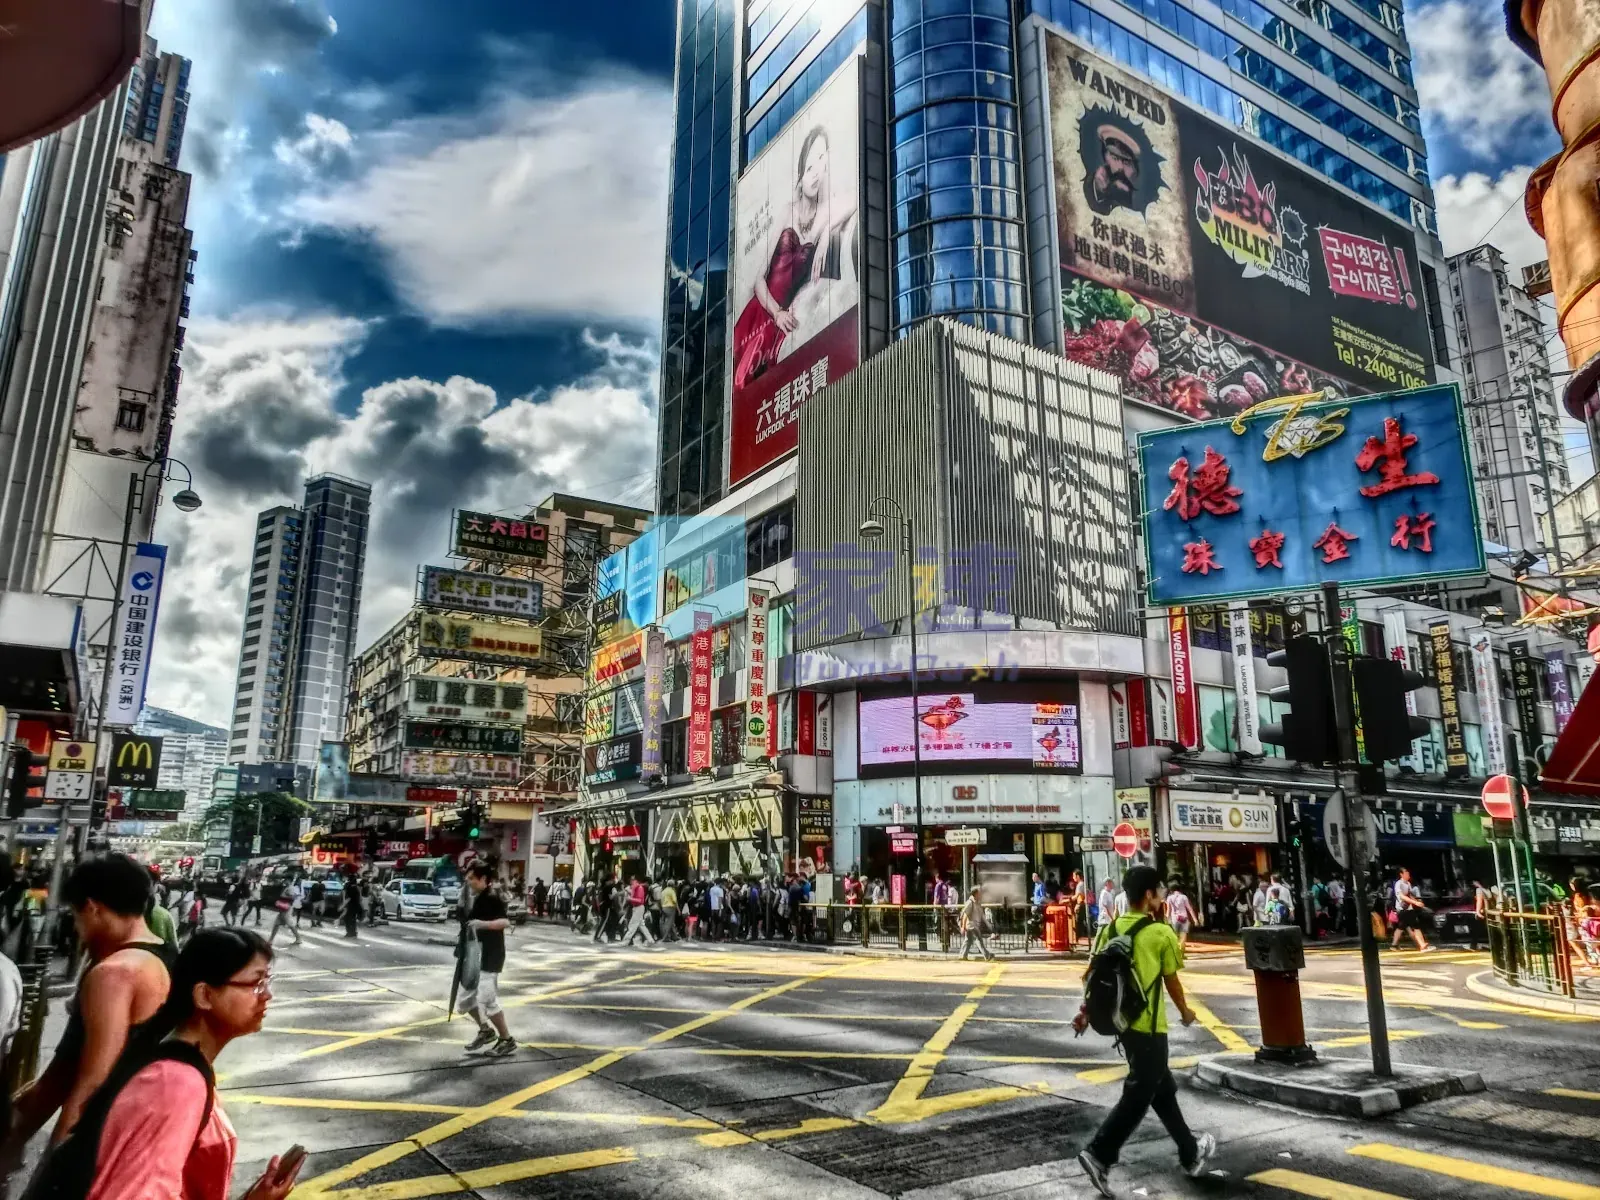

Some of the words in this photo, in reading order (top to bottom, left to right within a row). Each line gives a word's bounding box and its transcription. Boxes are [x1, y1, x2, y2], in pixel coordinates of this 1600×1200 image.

[1066, 55, 1166, 126] WANTED
[1091, 216, 1166, 265] 你試過未
[756, 355, 828, 432] 六福珠寶
[1363, 355, 1396, 383] 2408
[756, 417, 785, 445] LUKFOOK
[1181, 512, 1437, 575] 珠寶金行
[750, 613, 765, 716] 至尊重慶雞煲
[1173, 632, 1187, 694] wellcome
[1433, 636, 1462, 749] 彩福婚宴專門店
[74, 788, 82, 797] 7
[76, 774, 84, 784] 7
[1244, 810, 1269, 823] SUN
